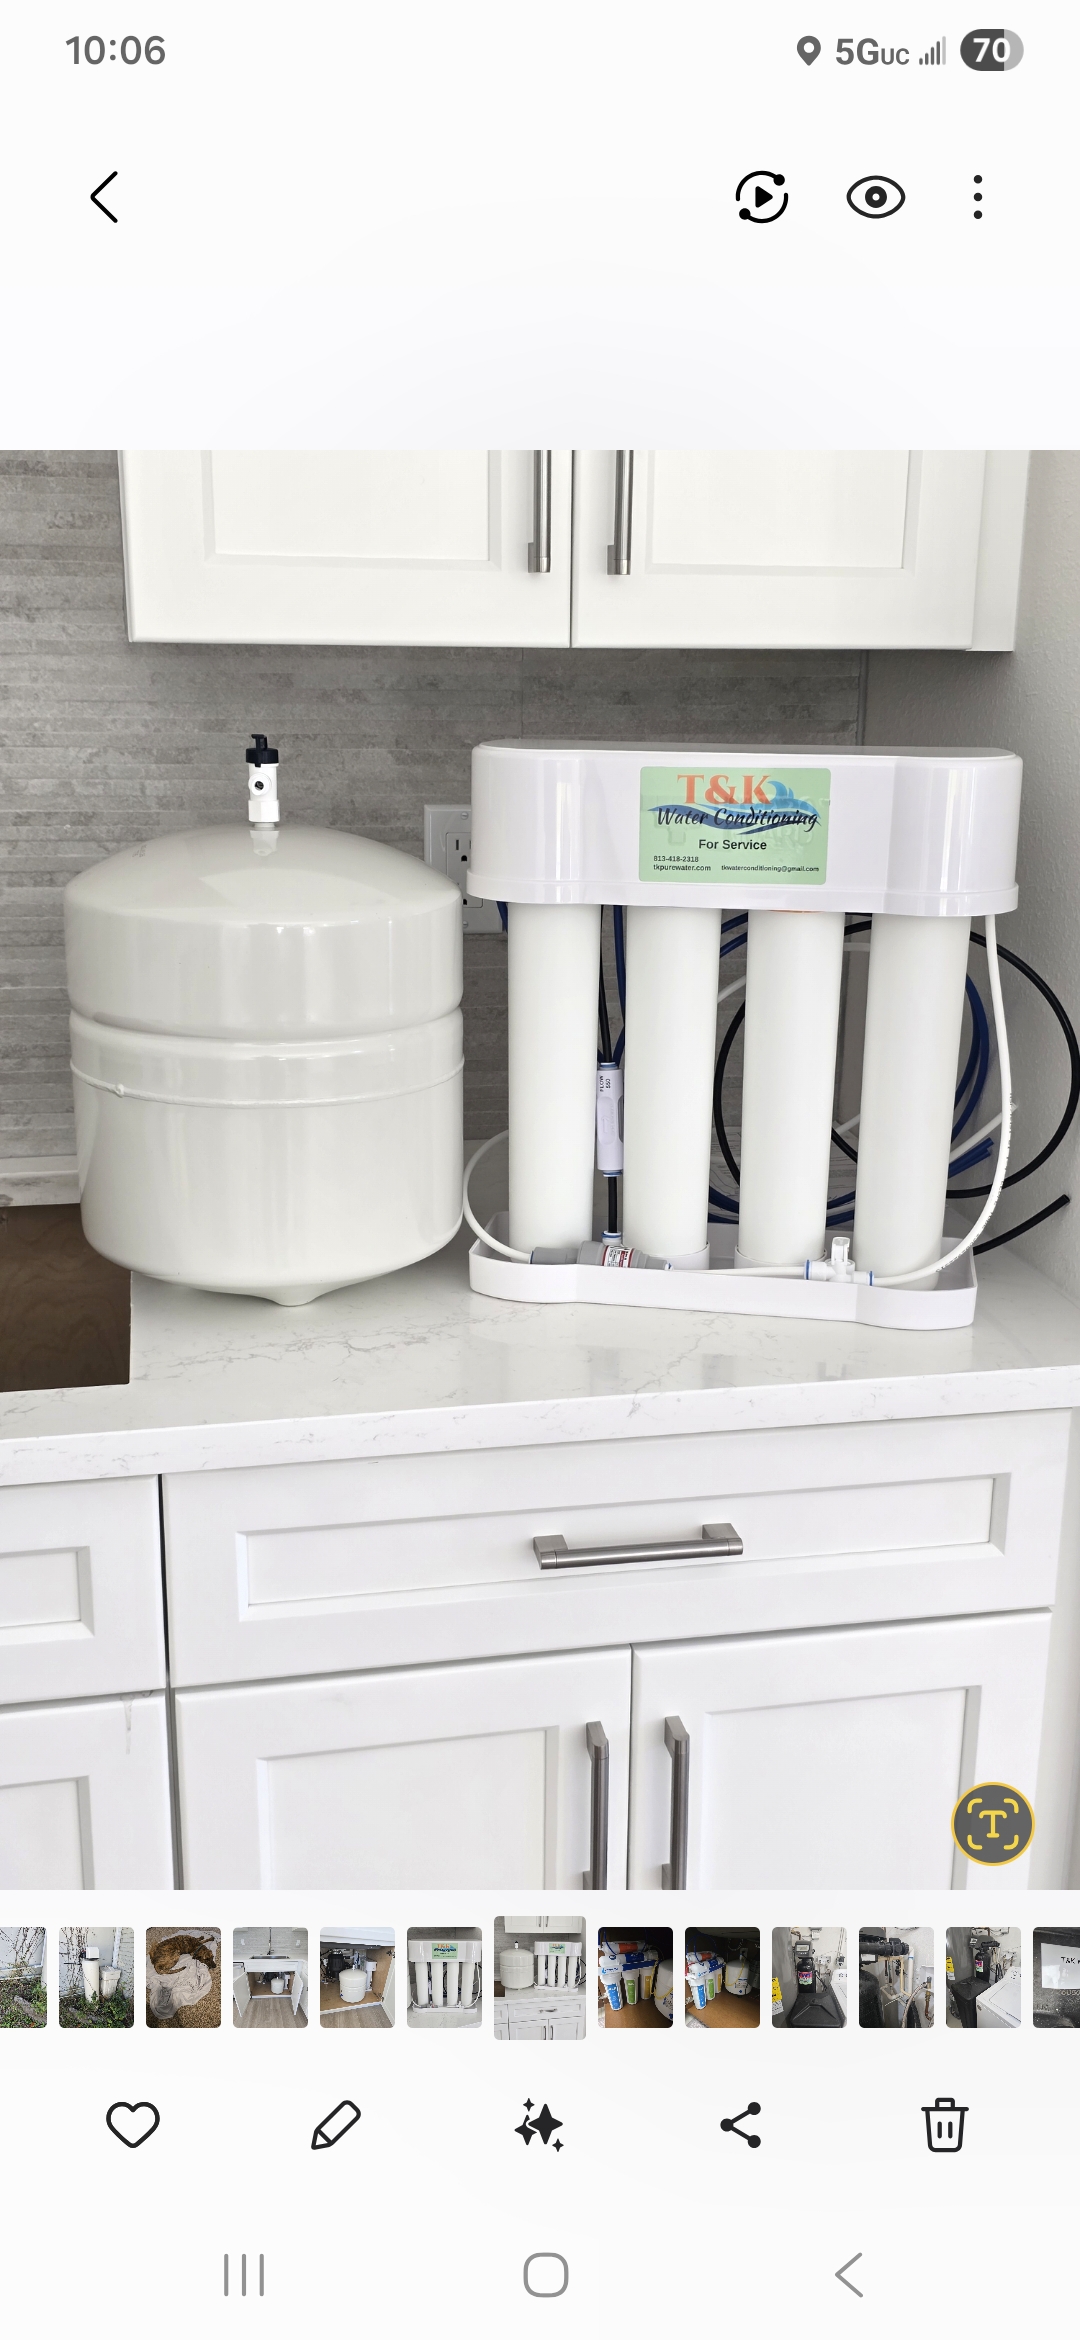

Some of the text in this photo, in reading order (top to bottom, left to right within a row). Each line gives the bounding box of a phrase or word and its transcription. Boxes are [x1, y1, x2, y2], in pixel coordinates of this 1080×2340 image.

[65, 35, 166, 65] 10:06
[972, 37, 1011, 63] 70
[677, 774, 771, 805] T&K
[657, 806, 819, 833] Water Conditioning
[698, 839, 719, 850] For
[722, 839, 767, 850] Service
[653, 855, 699, 863] 813-418-2318
[653, 864, 712, 872] tkpurewater.com
[721, 864, 820, 873] tkwaterconditioning@gmail.com
